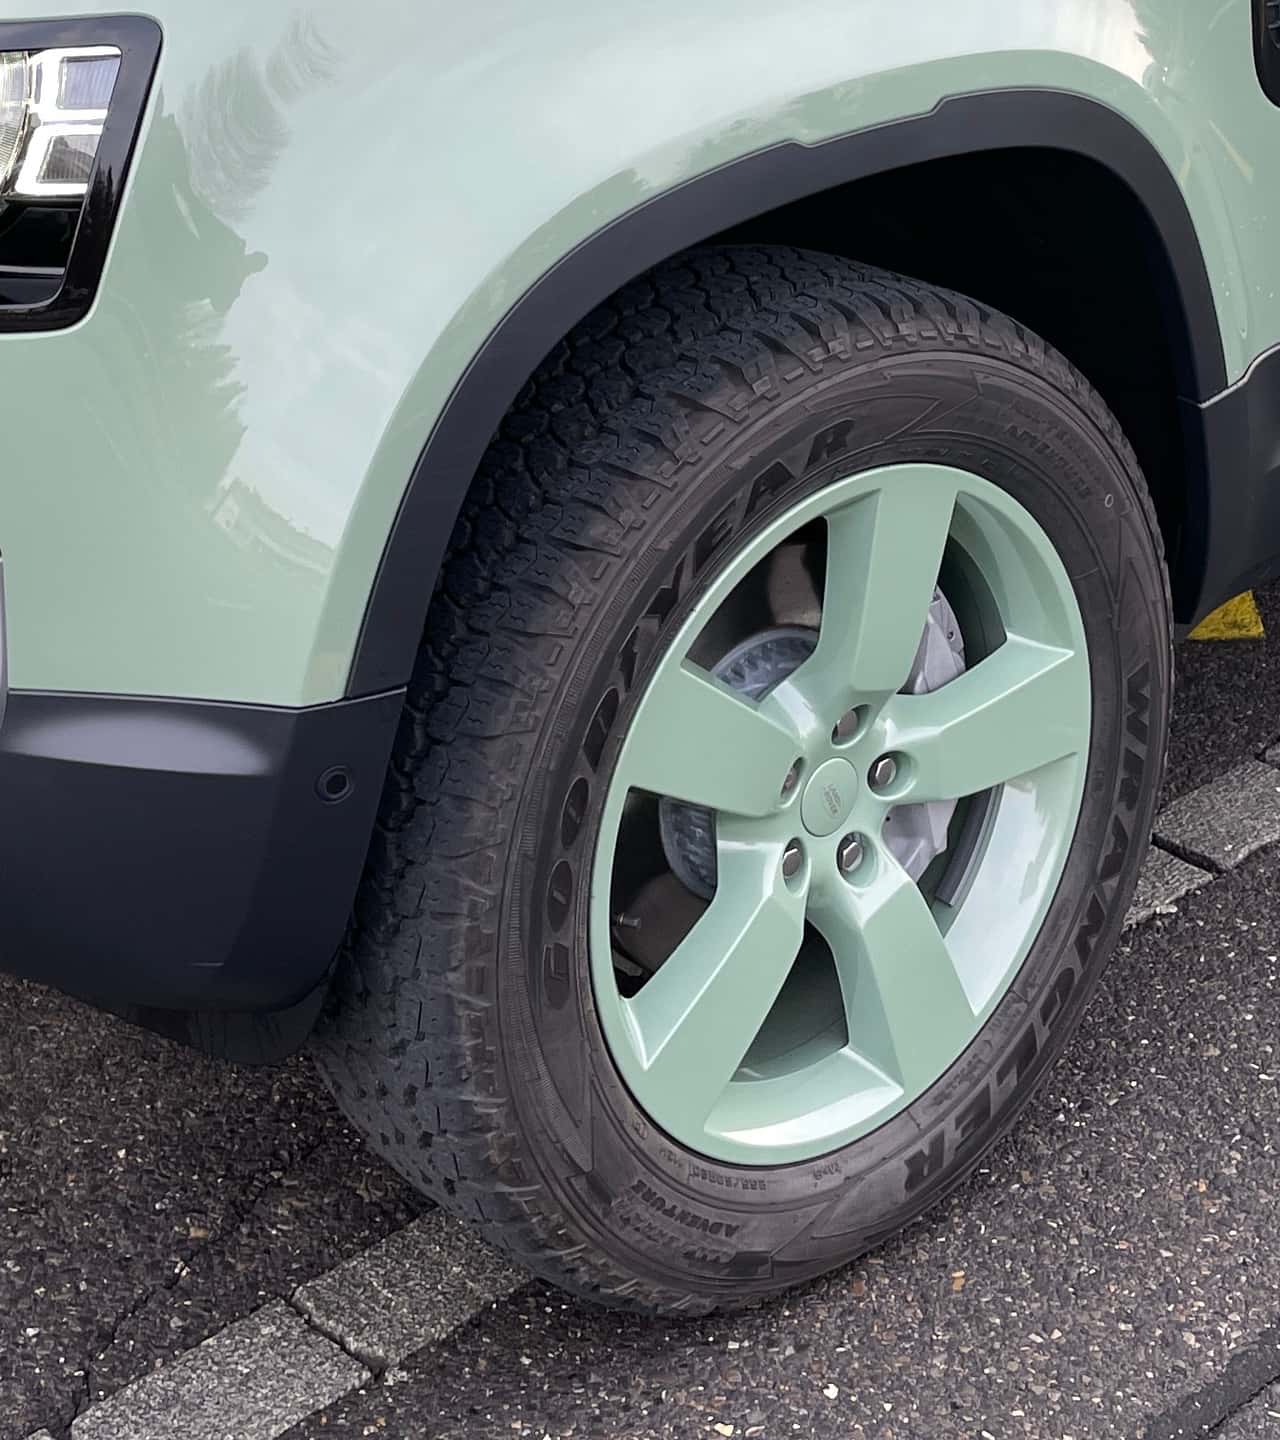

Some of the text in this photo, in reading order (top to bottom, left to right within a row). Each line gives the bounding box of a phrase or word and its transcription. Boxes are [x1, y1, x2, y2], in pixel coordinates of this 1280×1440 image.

[541, 417, 857, 1010] GOODYEAR
[903, 662, 1152, 1195] WRANGLER
[630, 1178, 741, 1239] ADVENTURE
